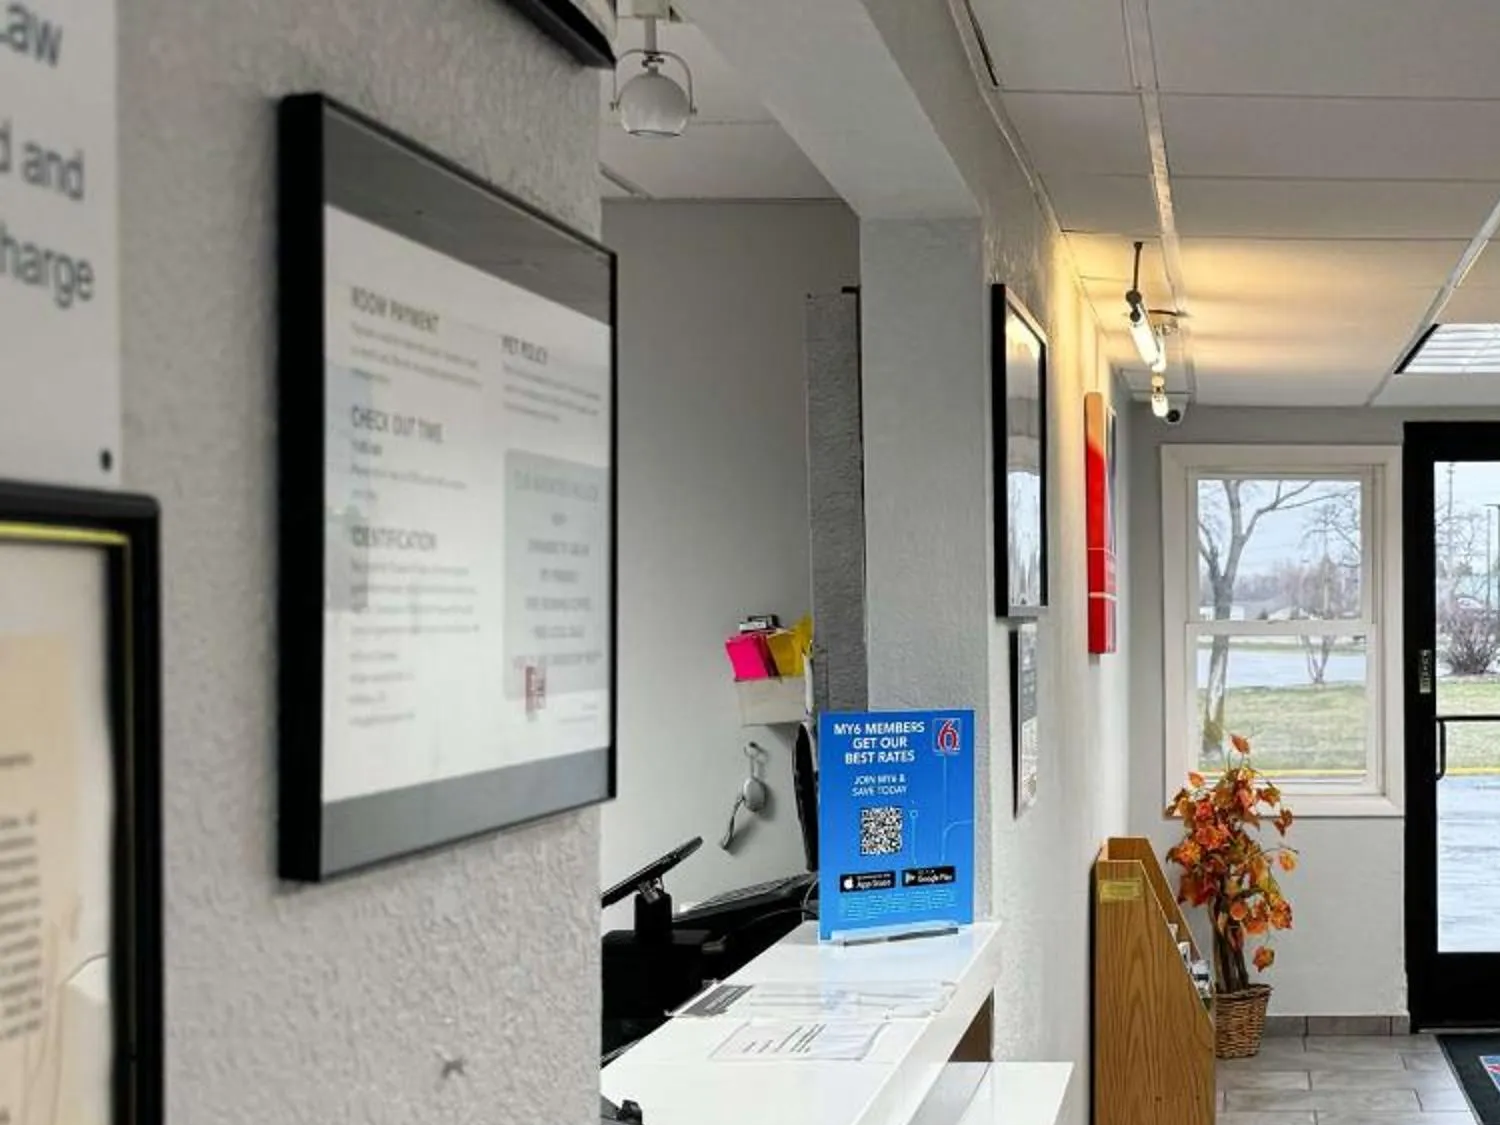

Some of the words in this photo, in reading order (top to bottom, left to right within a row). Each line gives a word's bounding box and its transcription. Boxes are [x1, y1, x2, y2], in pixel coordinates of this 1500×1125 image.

[0, 3, 62, 67] aw
[22, 141, 84, 201] and
[833, 723, 862, 735] MY6
[865, 721, 925, 734] MEMBERS
[852, 737, 877, 749] GET
[879, 736, 908, 748] OUR
[845, 751, 876, 764] BEST
[878, 750, 916, 763] RATES
